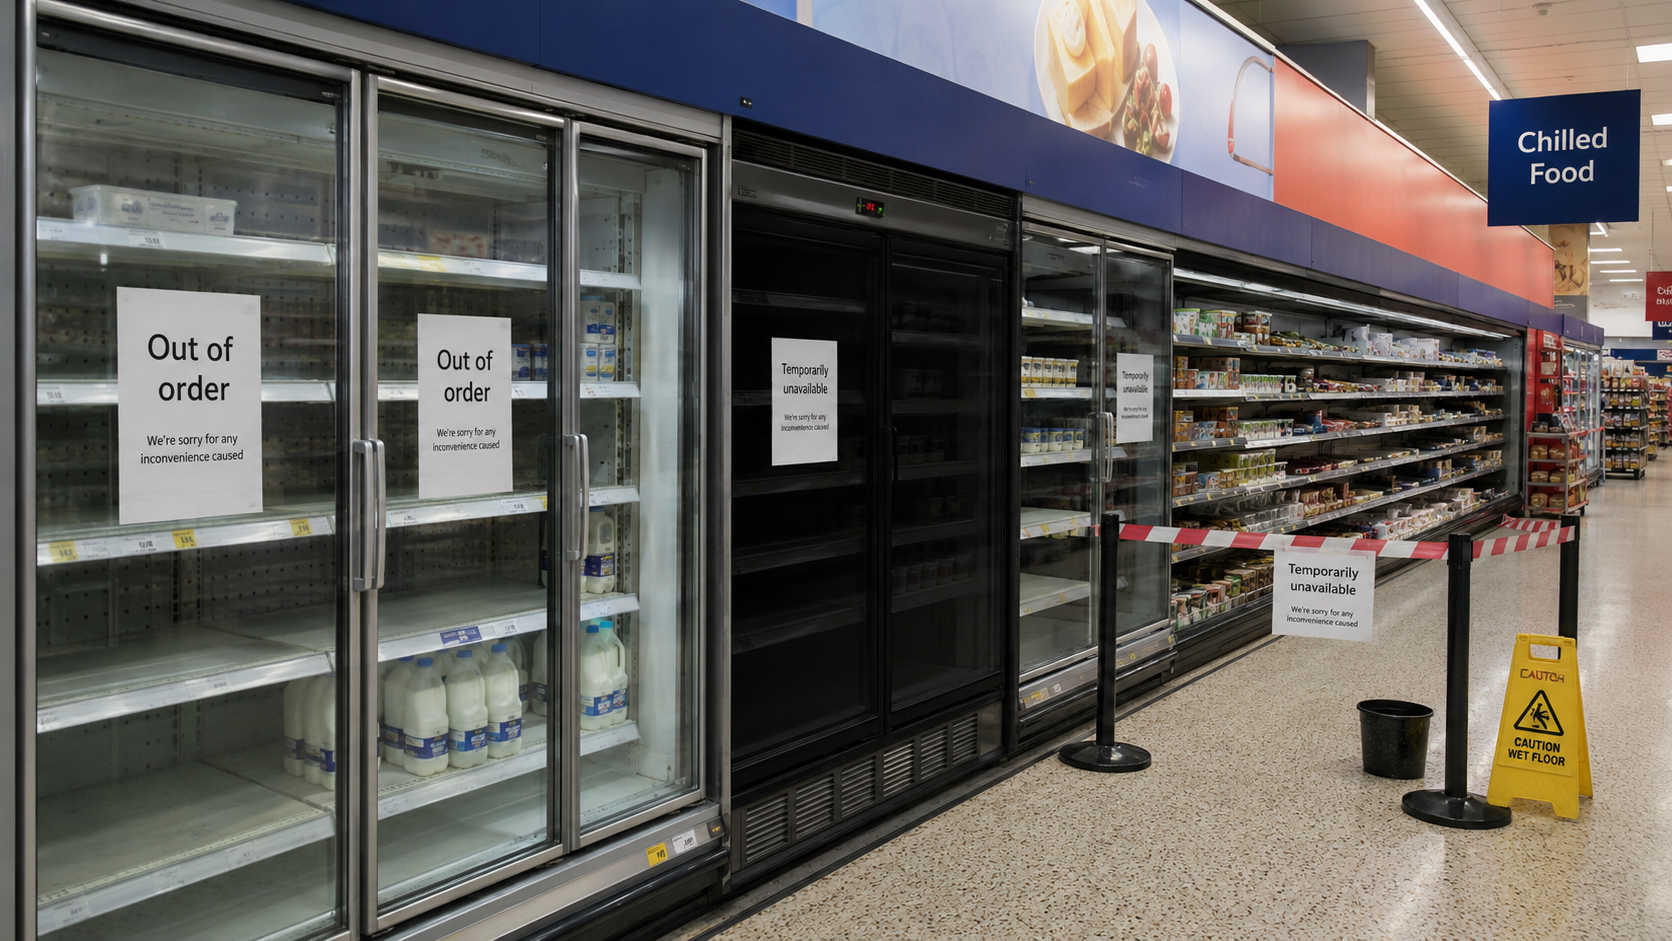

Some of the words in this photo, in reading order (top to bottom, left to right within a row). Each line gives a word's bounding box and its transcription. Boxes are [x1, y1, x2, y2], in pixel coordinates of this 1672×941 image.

[1517, 126, 1608, 154] Chilled
[1530, 159, 1594, 185] Food
[147, 333, 199, 361] Out
[206, 335, 234, 361] of
[437, 349, 470, 370] Out
[475, 349, 494, 371] of
[782, 363, 828, 378] Temporarily
[158, 374, 231, 402] order
[444, 380, 491, 402] order
[783, 382, 828, 395] unavailable
[146, 434, 176, 446] We're
[178, 435, 203, 447] sorry
[205, 433, 219, 444] for
[221, 434, 238, 446] any
[436, 428, 456, 437] We're
[456, 428, 473, 438] sorry
[474, 427, 484, 436] for
[484, 428, 496, 437] any
[432, 441, 477, 452] inconvenience
[478, 440, 500, 450] caused
[140, 452, 210, 465] inconvenience
[212, 449, 244, 461] caused
[1288, 563, 1359, 581] Temporarily
[1290, 582, 1356, 596] unavailable
[1290, 605, 1310, 614] We're
[1311, 608, 1328, 617] sorry
[1330, 608, 1340, 617] for
[1341, 611, 1354, 619] any
[1286, 614, 1334, 626] inconvenience
[1334, 620, 1359, 628] caused
[1513, 736, 1561, 753] CAUTION
[1507, 748, 1530, 761] WET
[1531, 752, 1566, 767] FLOOR
